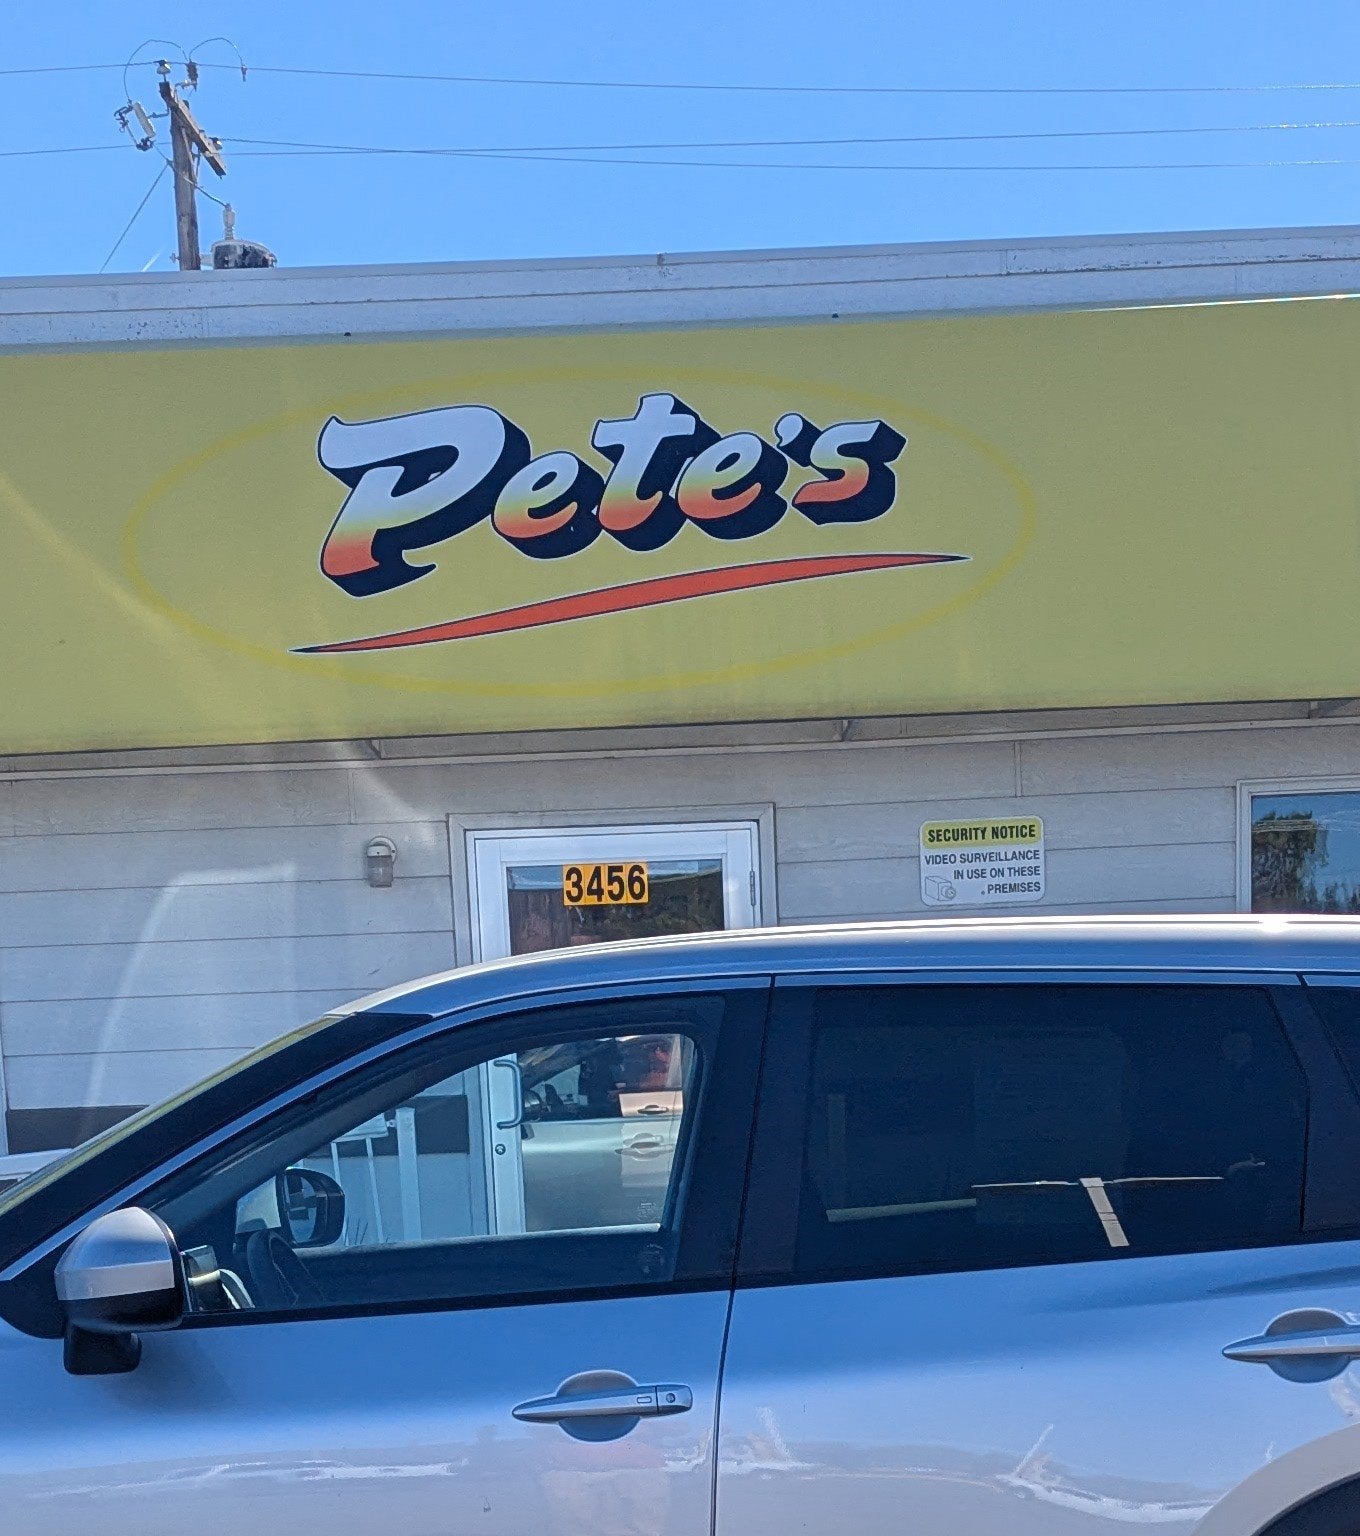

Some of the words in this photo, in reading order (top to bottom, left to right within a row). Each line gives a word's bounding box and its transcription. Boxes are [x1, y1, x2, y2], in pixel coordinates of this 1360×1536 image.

[316, 392, 907, 597] Pete's
[927, 826, 987, 842] SECURITY
[991, 824, 1036, 839] NOTICE
[924, 853, 957, 865] VIDEO
[959, 850, 1040, 863] SURVEILLANCE
[953, 869, 964, 880] IN
[966, 867, 987, 879] USE
[989, 867, 1005, 878] ON
[1007, 865, 1041, 877] THESE
[565, 864, 646, 903] 3456
[987, 881, 1041, 894] PREMISES
